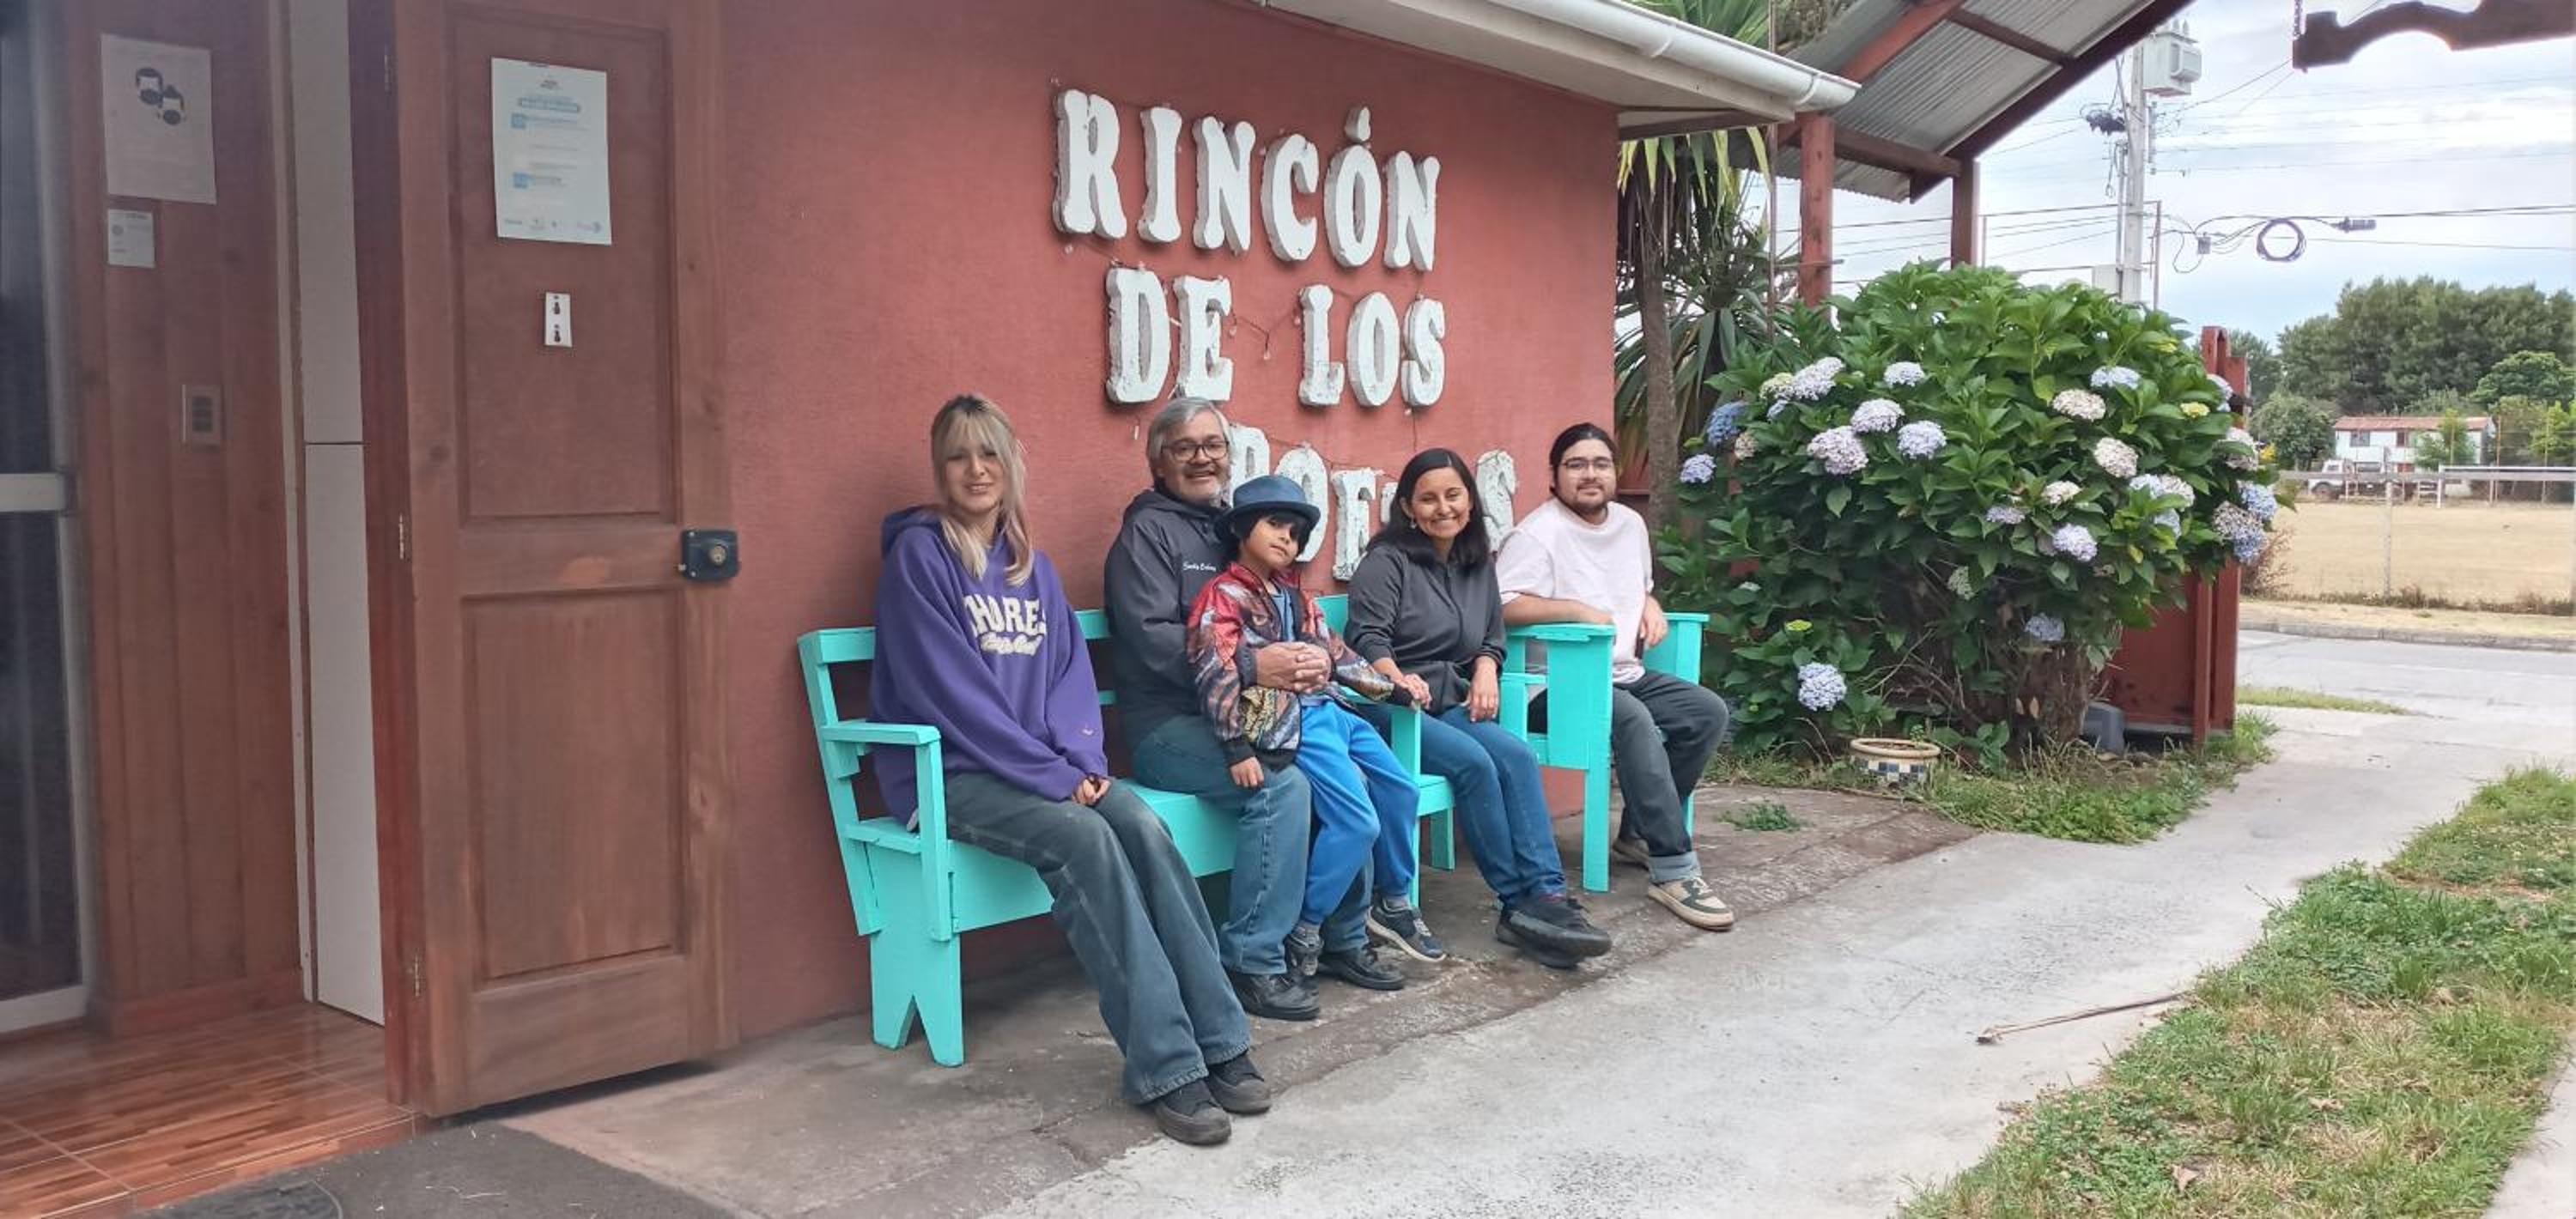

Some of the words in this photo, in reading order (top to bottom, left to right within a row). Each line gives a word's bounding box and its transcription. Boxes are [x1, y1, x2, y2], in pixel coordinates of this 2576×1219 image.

[1053, 89, 1440, 271] RINCÓN
[1106, 268, 1233, 403] DE
[1299, 284, 1446, 407] LOS
